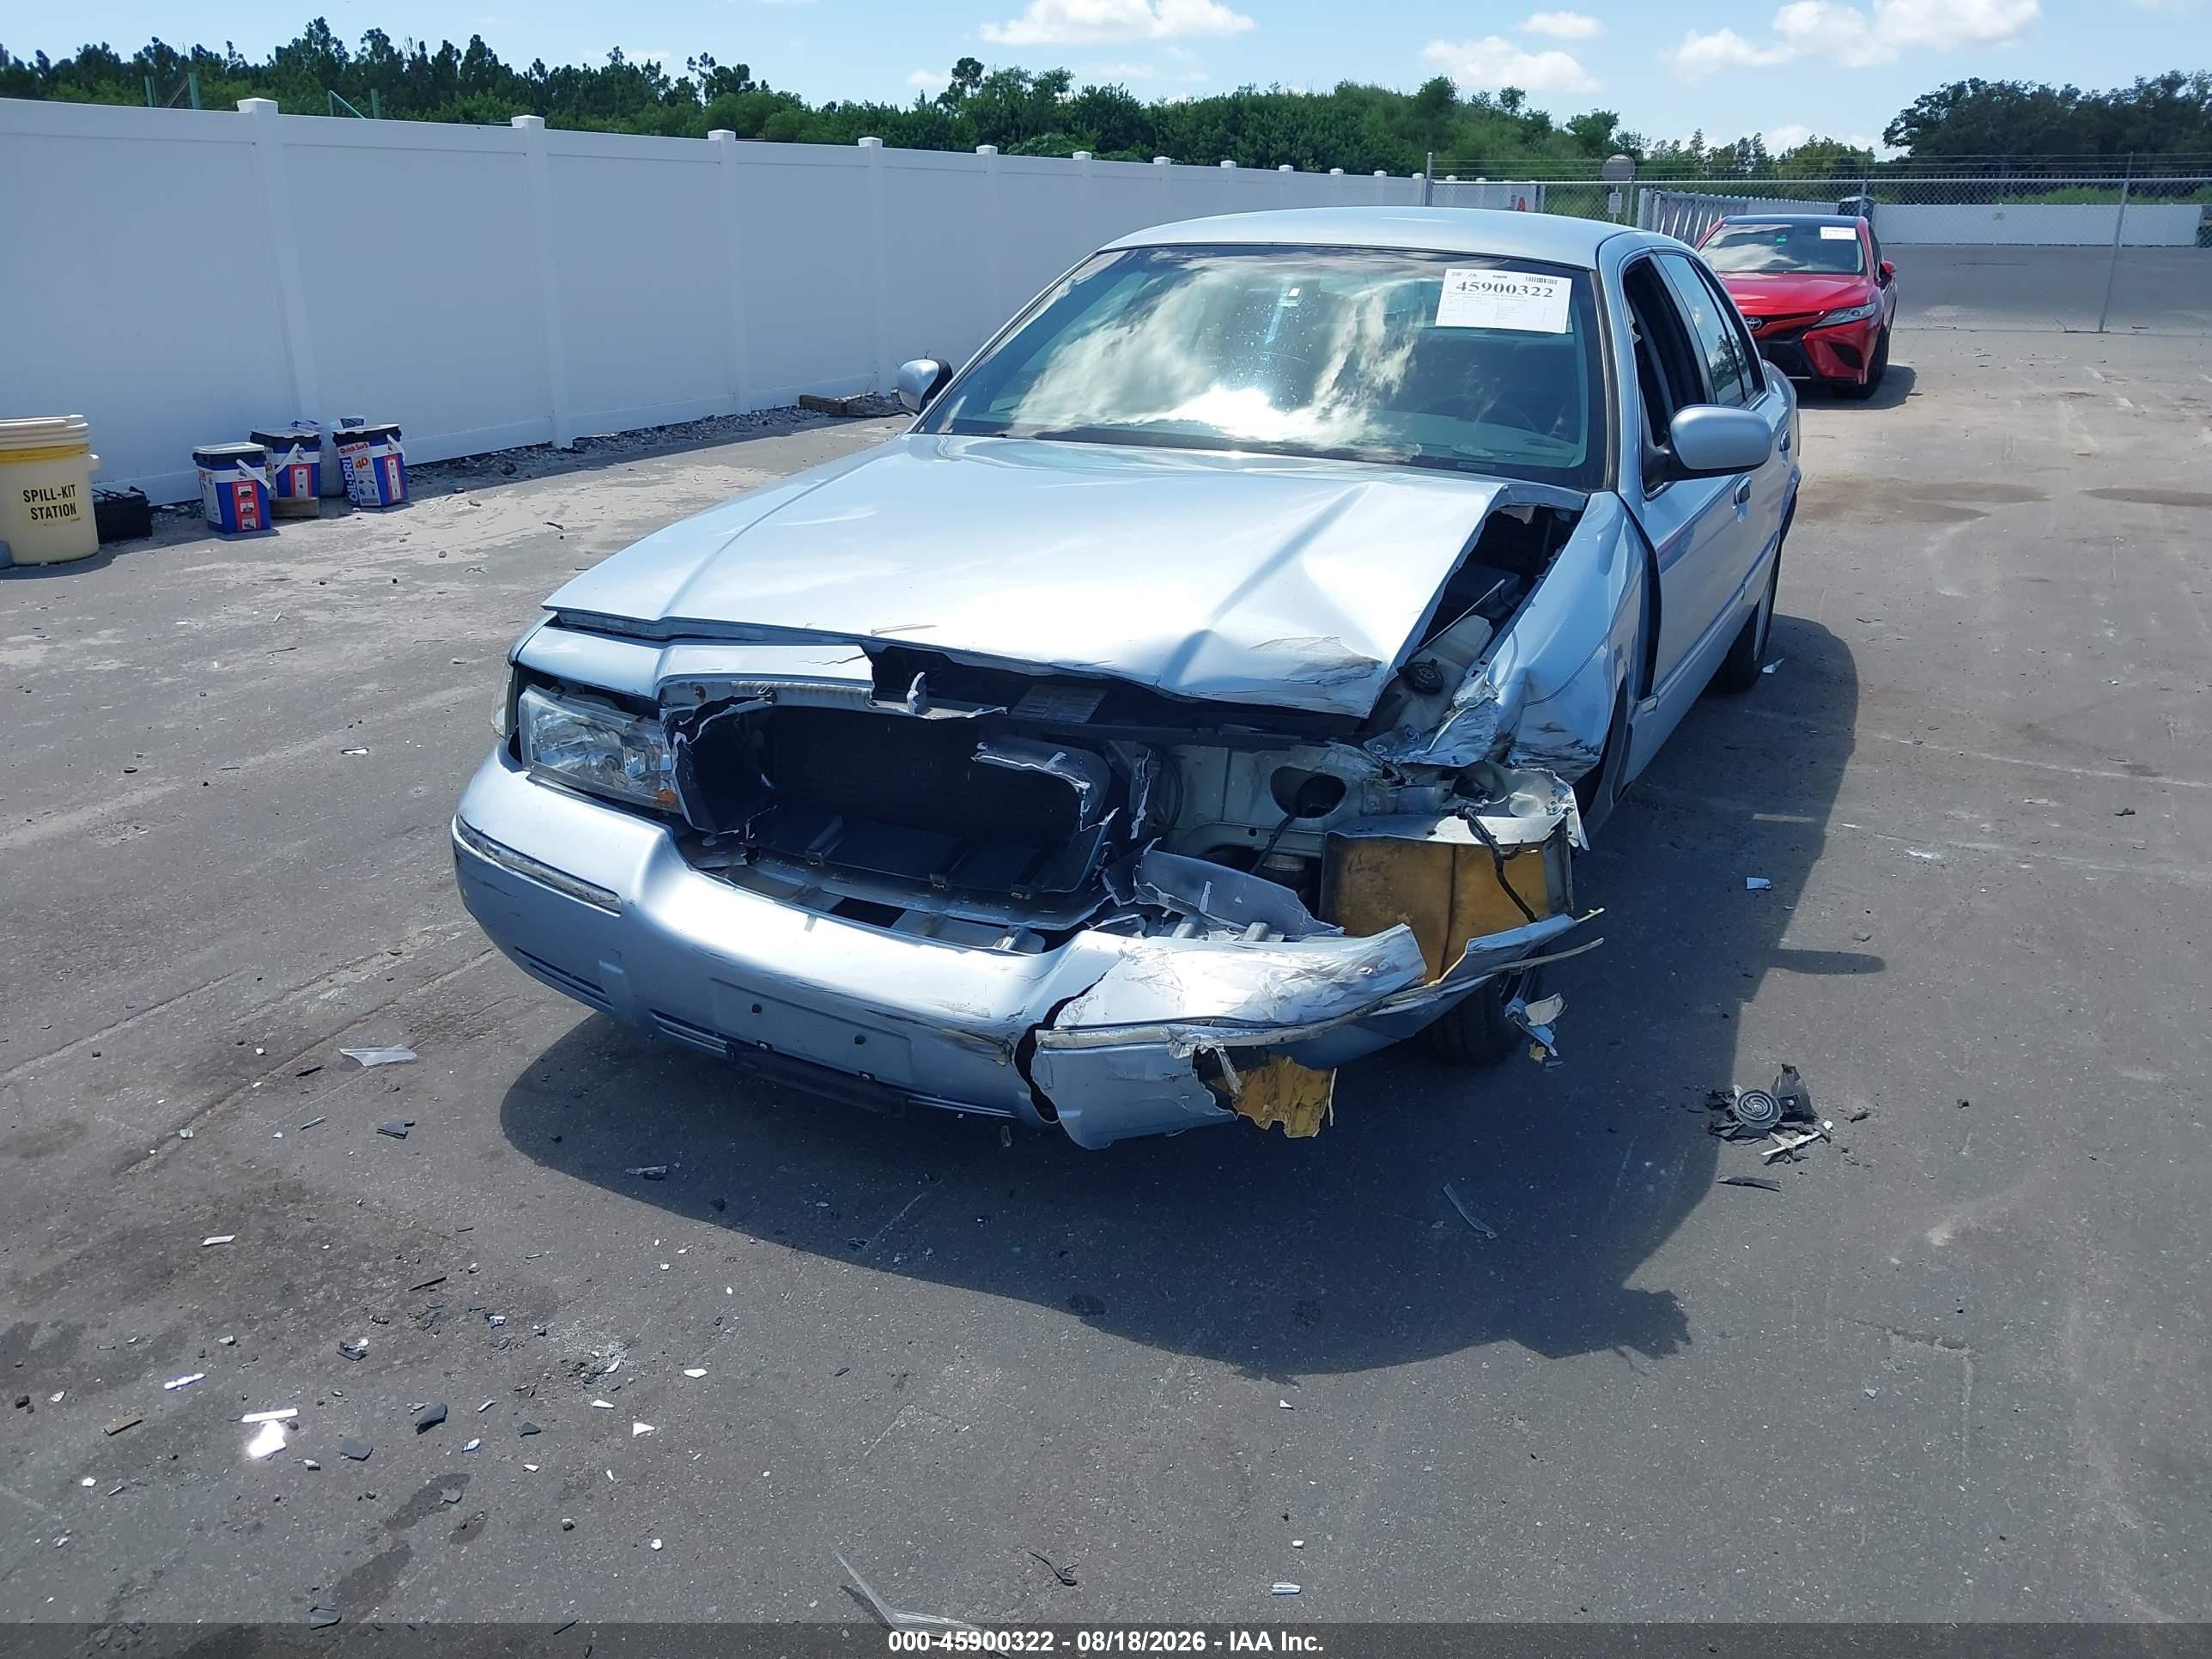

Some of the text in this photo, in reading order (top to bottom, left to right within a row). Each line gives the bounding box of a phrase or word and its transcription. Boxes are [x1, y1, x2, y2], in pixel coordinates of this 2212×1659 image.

[1455, 281, 1553, 298] 45900322
[356, 457, 368, 469] 40
[22, 484, 76, 503] SPILL-KIT
[30, 502, 77, 520] STATION
